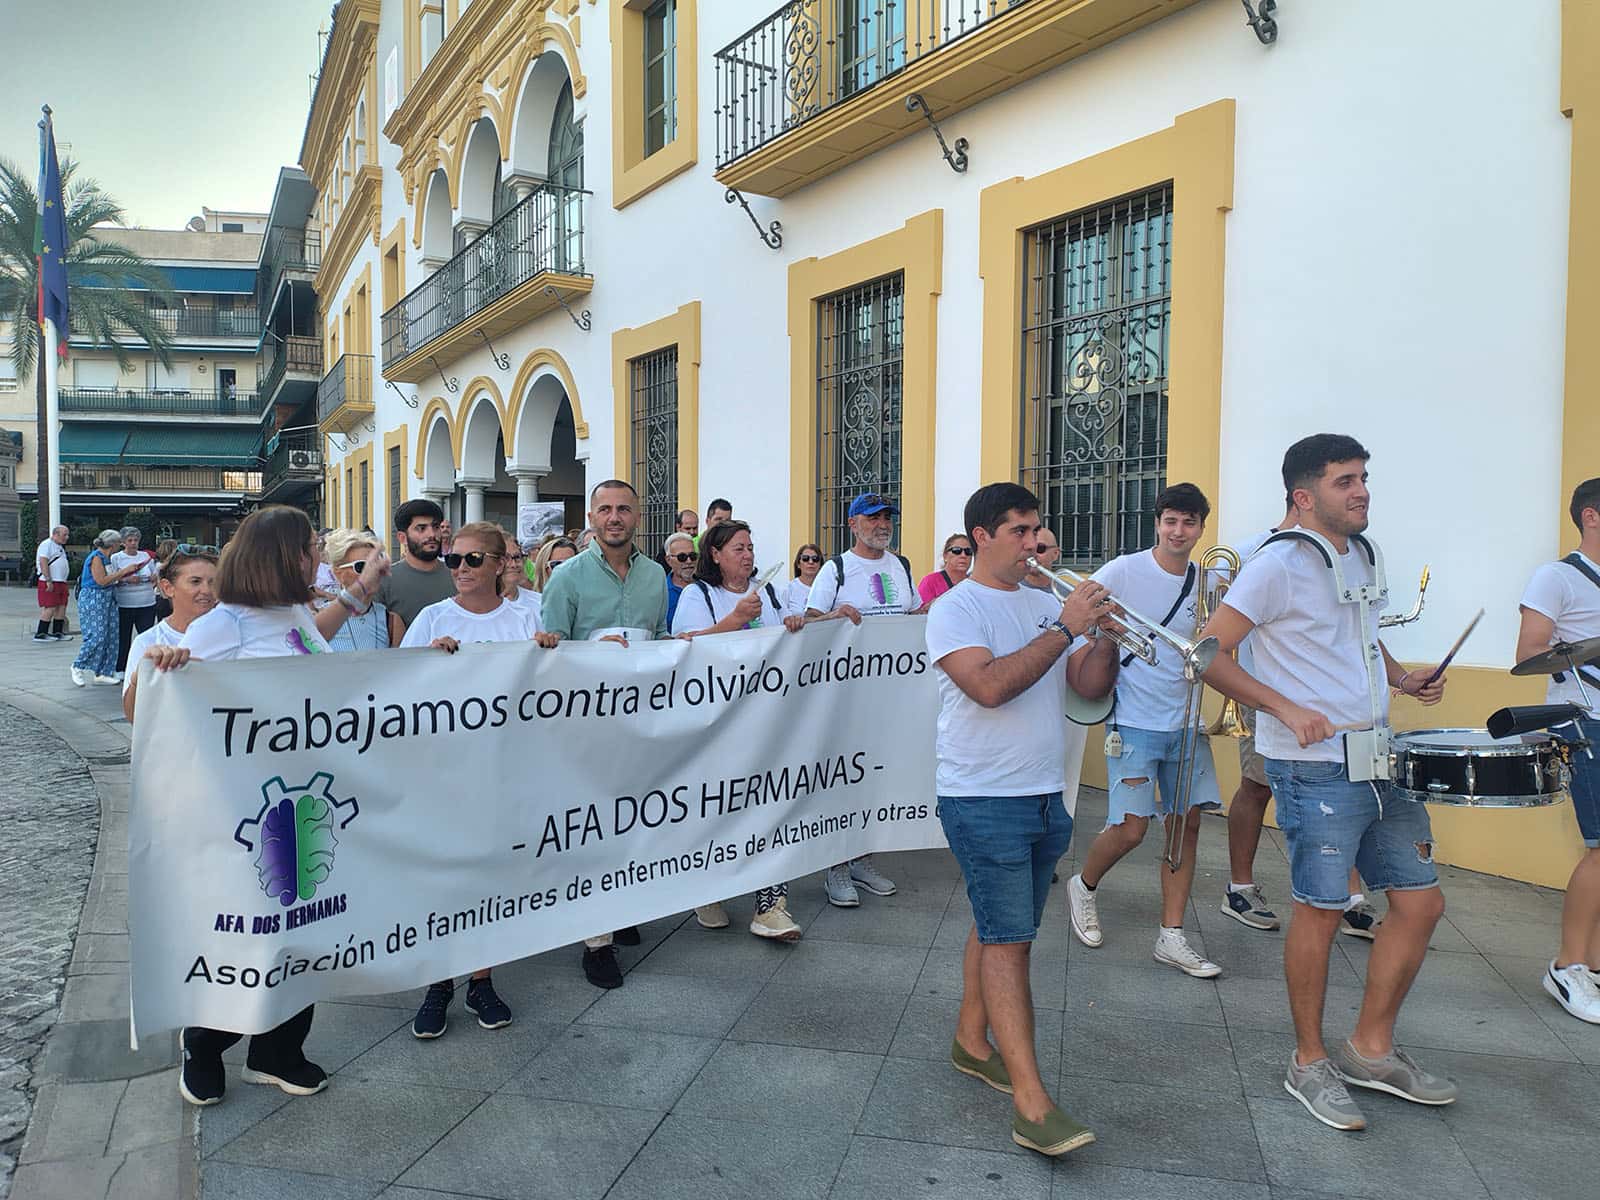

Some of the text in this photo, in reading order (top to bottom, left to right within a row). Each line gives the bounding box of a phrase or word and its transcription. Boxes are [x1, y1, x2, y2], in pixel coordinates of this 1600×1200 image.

[211, 646, 927, 758] Trabajamos contra el olvido, cuidamos
[535, 803, 604, 858] AFA
[614, 785, 689, 836] DOS
[699, 751, 866, 818] HERMANAS
[185, 934, 375, 989] Asociación
[386, 923, 417, 954] de
[426, 888, 558, 941] familiares
[566, 875, 593, 902] de
[600, 840, 738, 892] enfermos/as
[745, 833, 766, 857] de
[771, 811, 857, 849] Alzheimer
[861, 809, 872, 830] y
[877, 803, 928, 822] otras
[214, 894, 347, 935] AFA DOS HERMANAS
